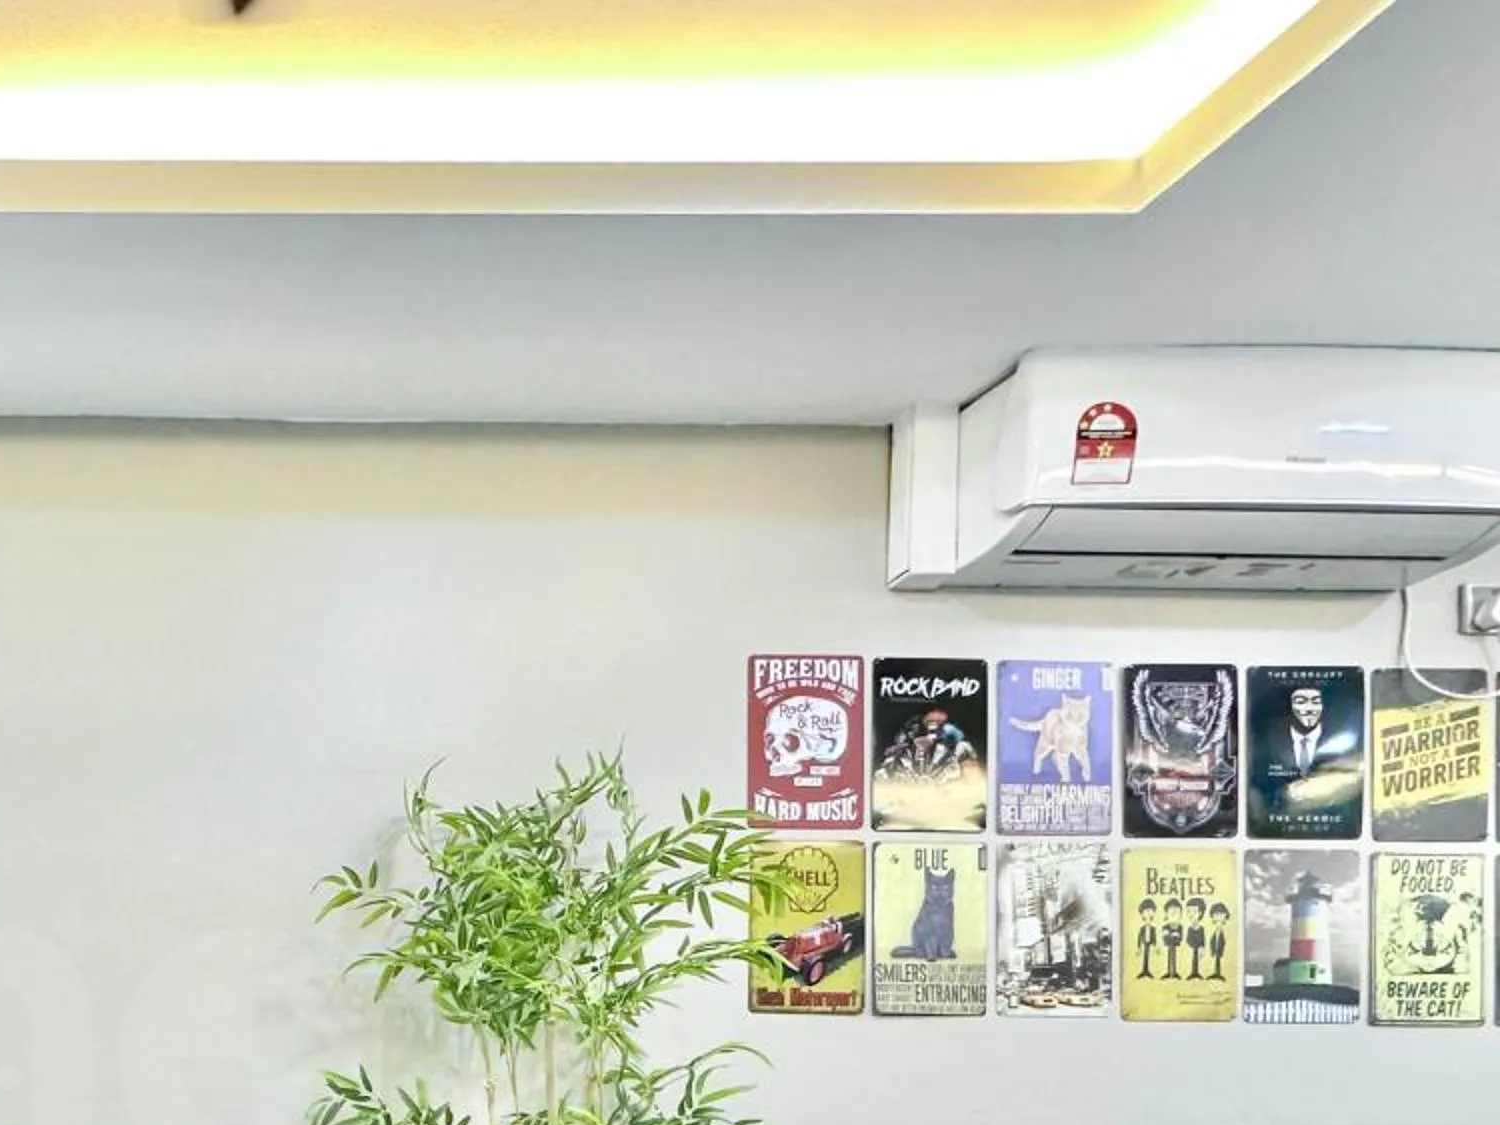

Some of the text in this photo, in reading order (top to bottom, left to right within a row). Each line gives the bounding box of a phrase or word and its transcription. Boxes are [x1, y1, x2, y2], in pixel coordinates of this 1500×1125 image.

[754, 659, 859, 691] FREEDOM
[880, 675, 980, 698] ROCK BAND
[779, 700, 812, 719] Rock
[1382, 719, 1480, 761] WARRIOR
[1408, 749, 1439, 767] NOT
[1381, 755, 1481, 797] WORRIER
[754, 791, 858, 821] HARD MUSIC
[915, 848, 949, 871] BLUE
[1174, 863, 1190, 874] THE
[1391, 858, 1469, 877] DO NOT BE
[784, 869, 831, 887] HELL
[1146, 866, 1216, 901] BEATLES
[875, 963, 928, 983] SMILERS
[915, 983, 987, 1004] ENTRANCING
[1386, 981, 1471, 999] BEWARE OF
[1396, 999, 1462, 1018] THE CAT!
